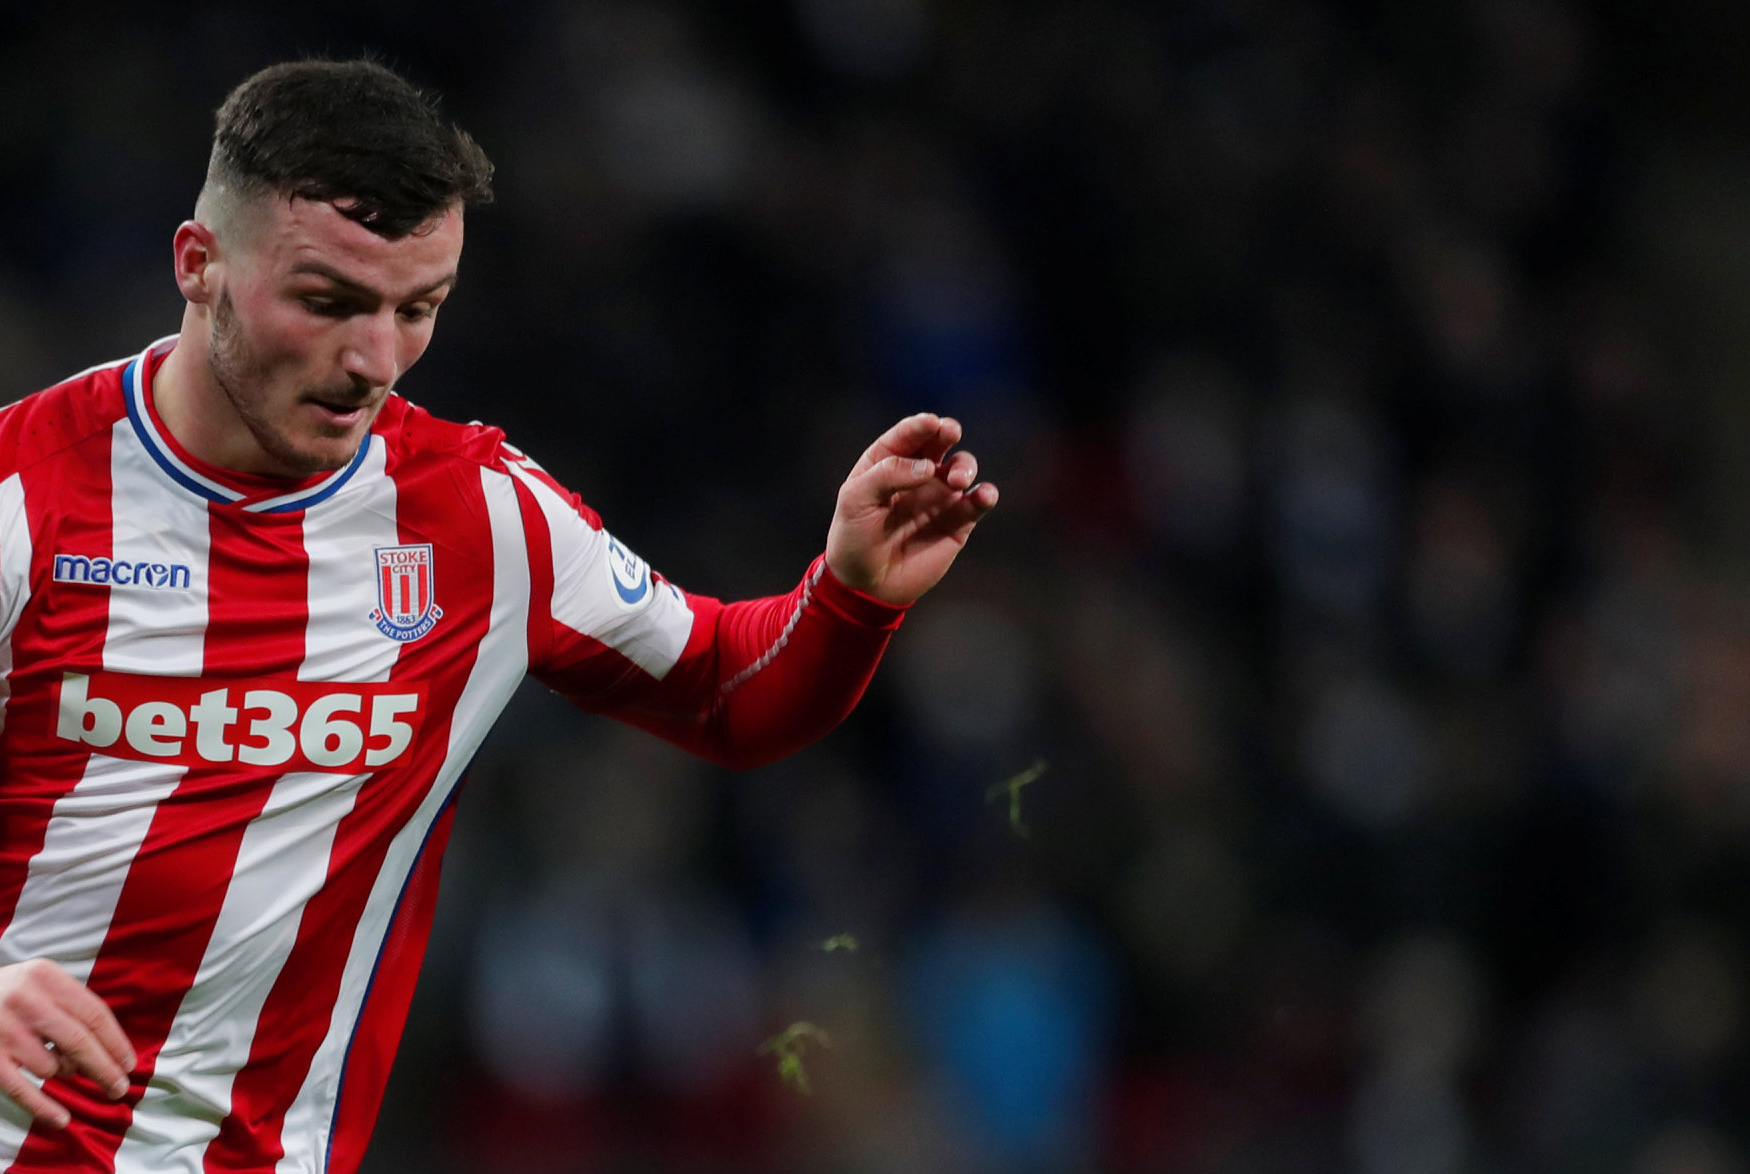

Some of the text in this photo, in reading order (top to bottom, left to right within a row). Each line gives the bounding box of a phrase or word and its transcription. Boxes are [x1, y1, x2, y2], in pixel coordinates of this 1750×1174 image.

[380, 550, 427, 565] STOKE
[54, 555, 191, 589] macron
[392, 564, 416, 574] CITY
[379, 619, 432, 640] THE POTTERS
[57, 672, 419, 767] bet365
